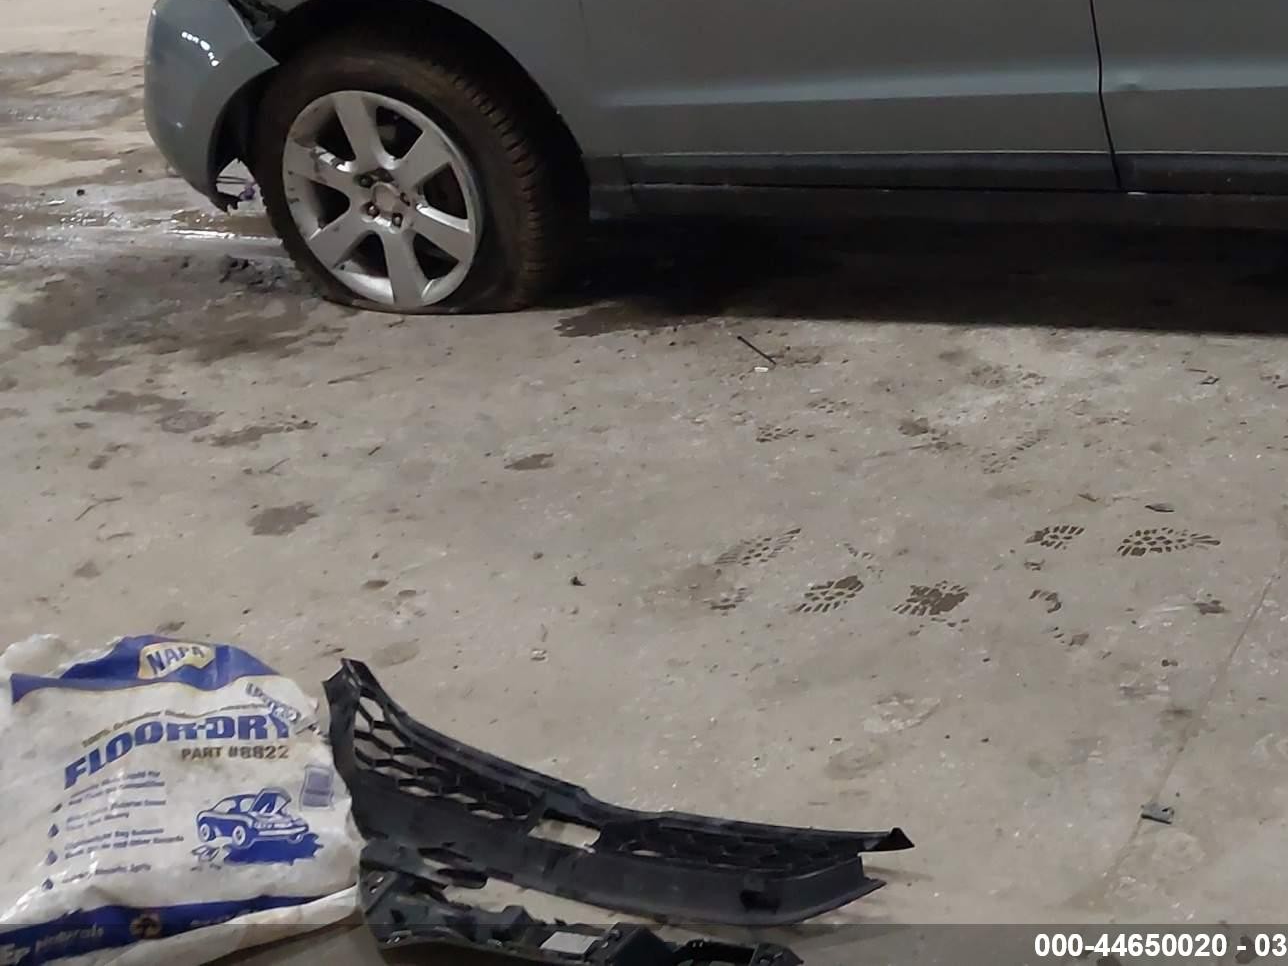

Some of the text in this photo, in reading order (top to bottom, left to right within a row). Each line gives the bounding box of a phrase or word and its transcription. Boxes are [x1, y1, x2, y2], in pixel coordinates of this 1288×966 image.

[146, 646, 205, 675] NAPA
[181, 745, 289, 760] PART #8822
